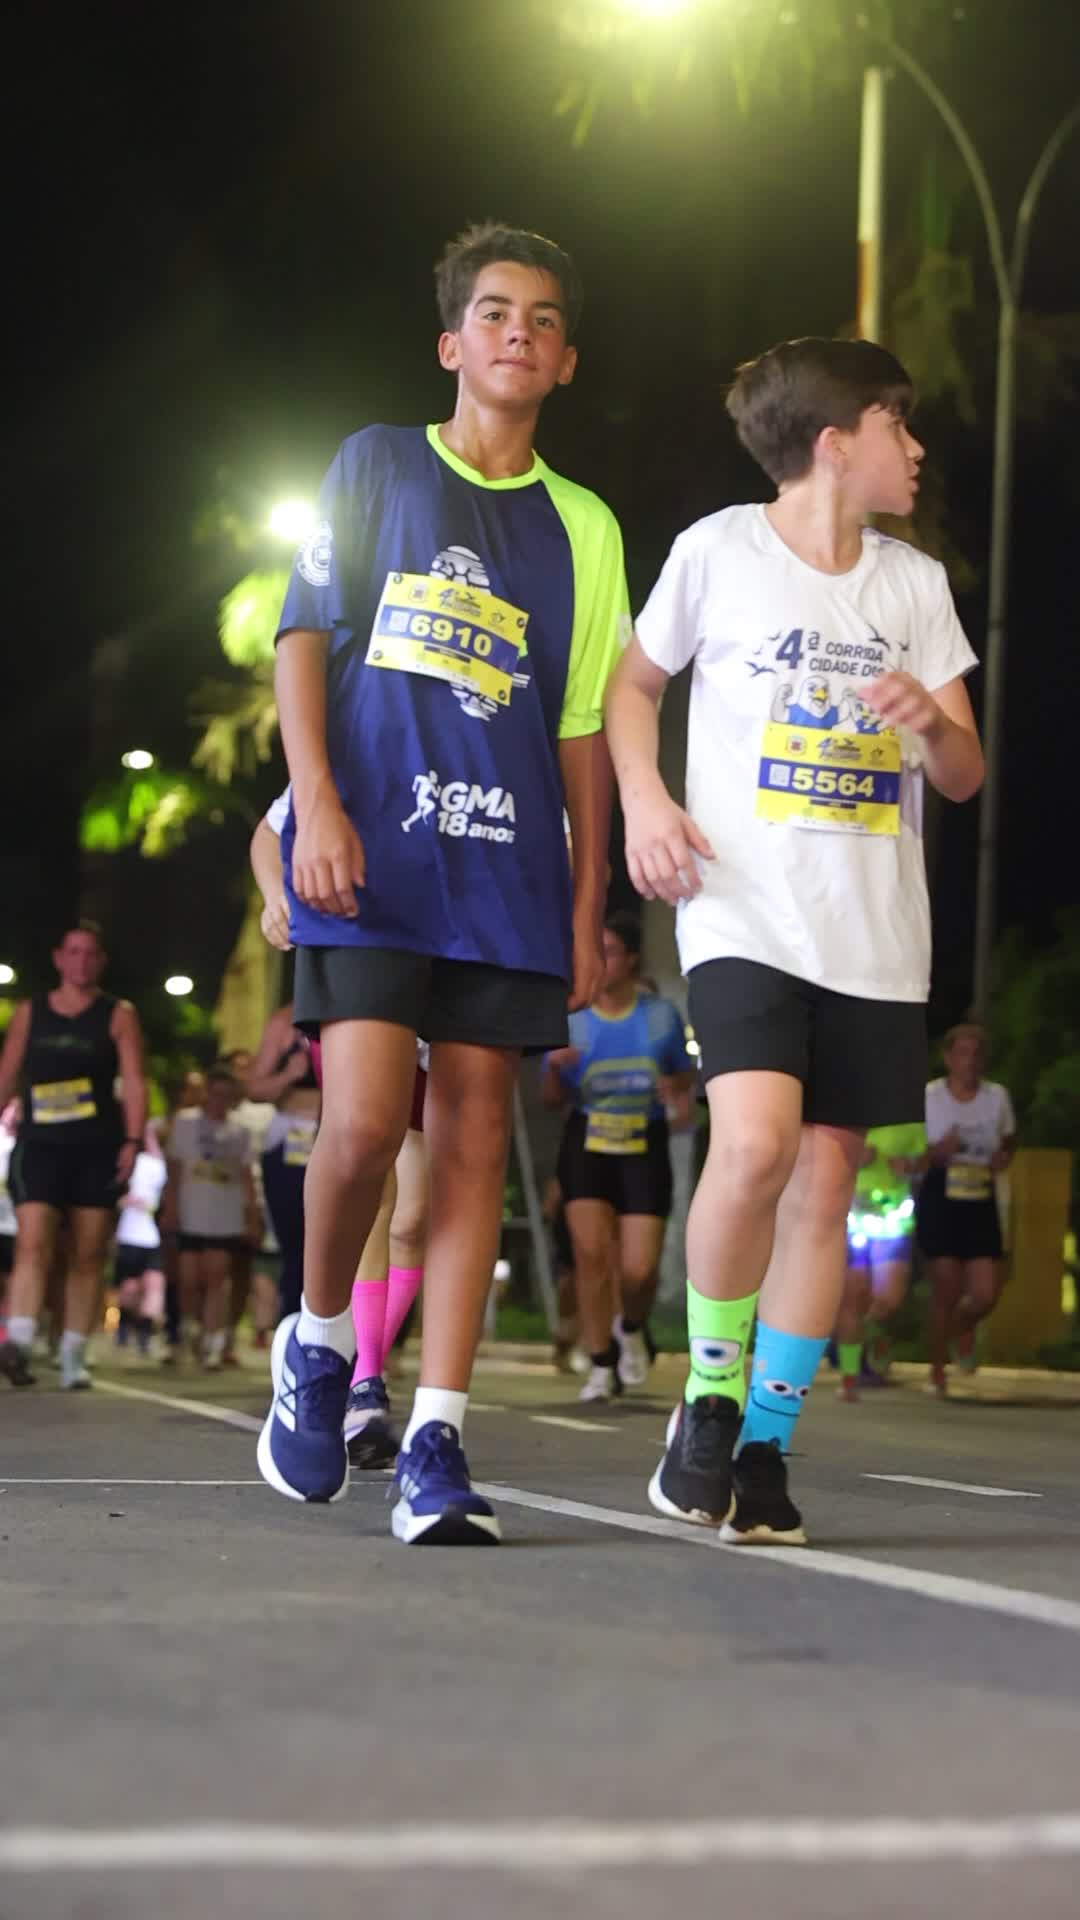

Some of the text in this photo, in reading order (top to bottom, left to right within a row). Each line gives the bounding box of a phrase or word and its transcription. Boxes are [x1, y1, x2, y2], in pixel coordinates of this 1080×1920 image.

[409, 613, 493, 657] 6910
[809, 657, 859, 676] CIDADE
[825, 641, 884, 663] CORRIDA
[791, 766, 875, 799] 5564
[440, 781, 516, 823] GMA
[437, 811, 516, 844] 18 anos
